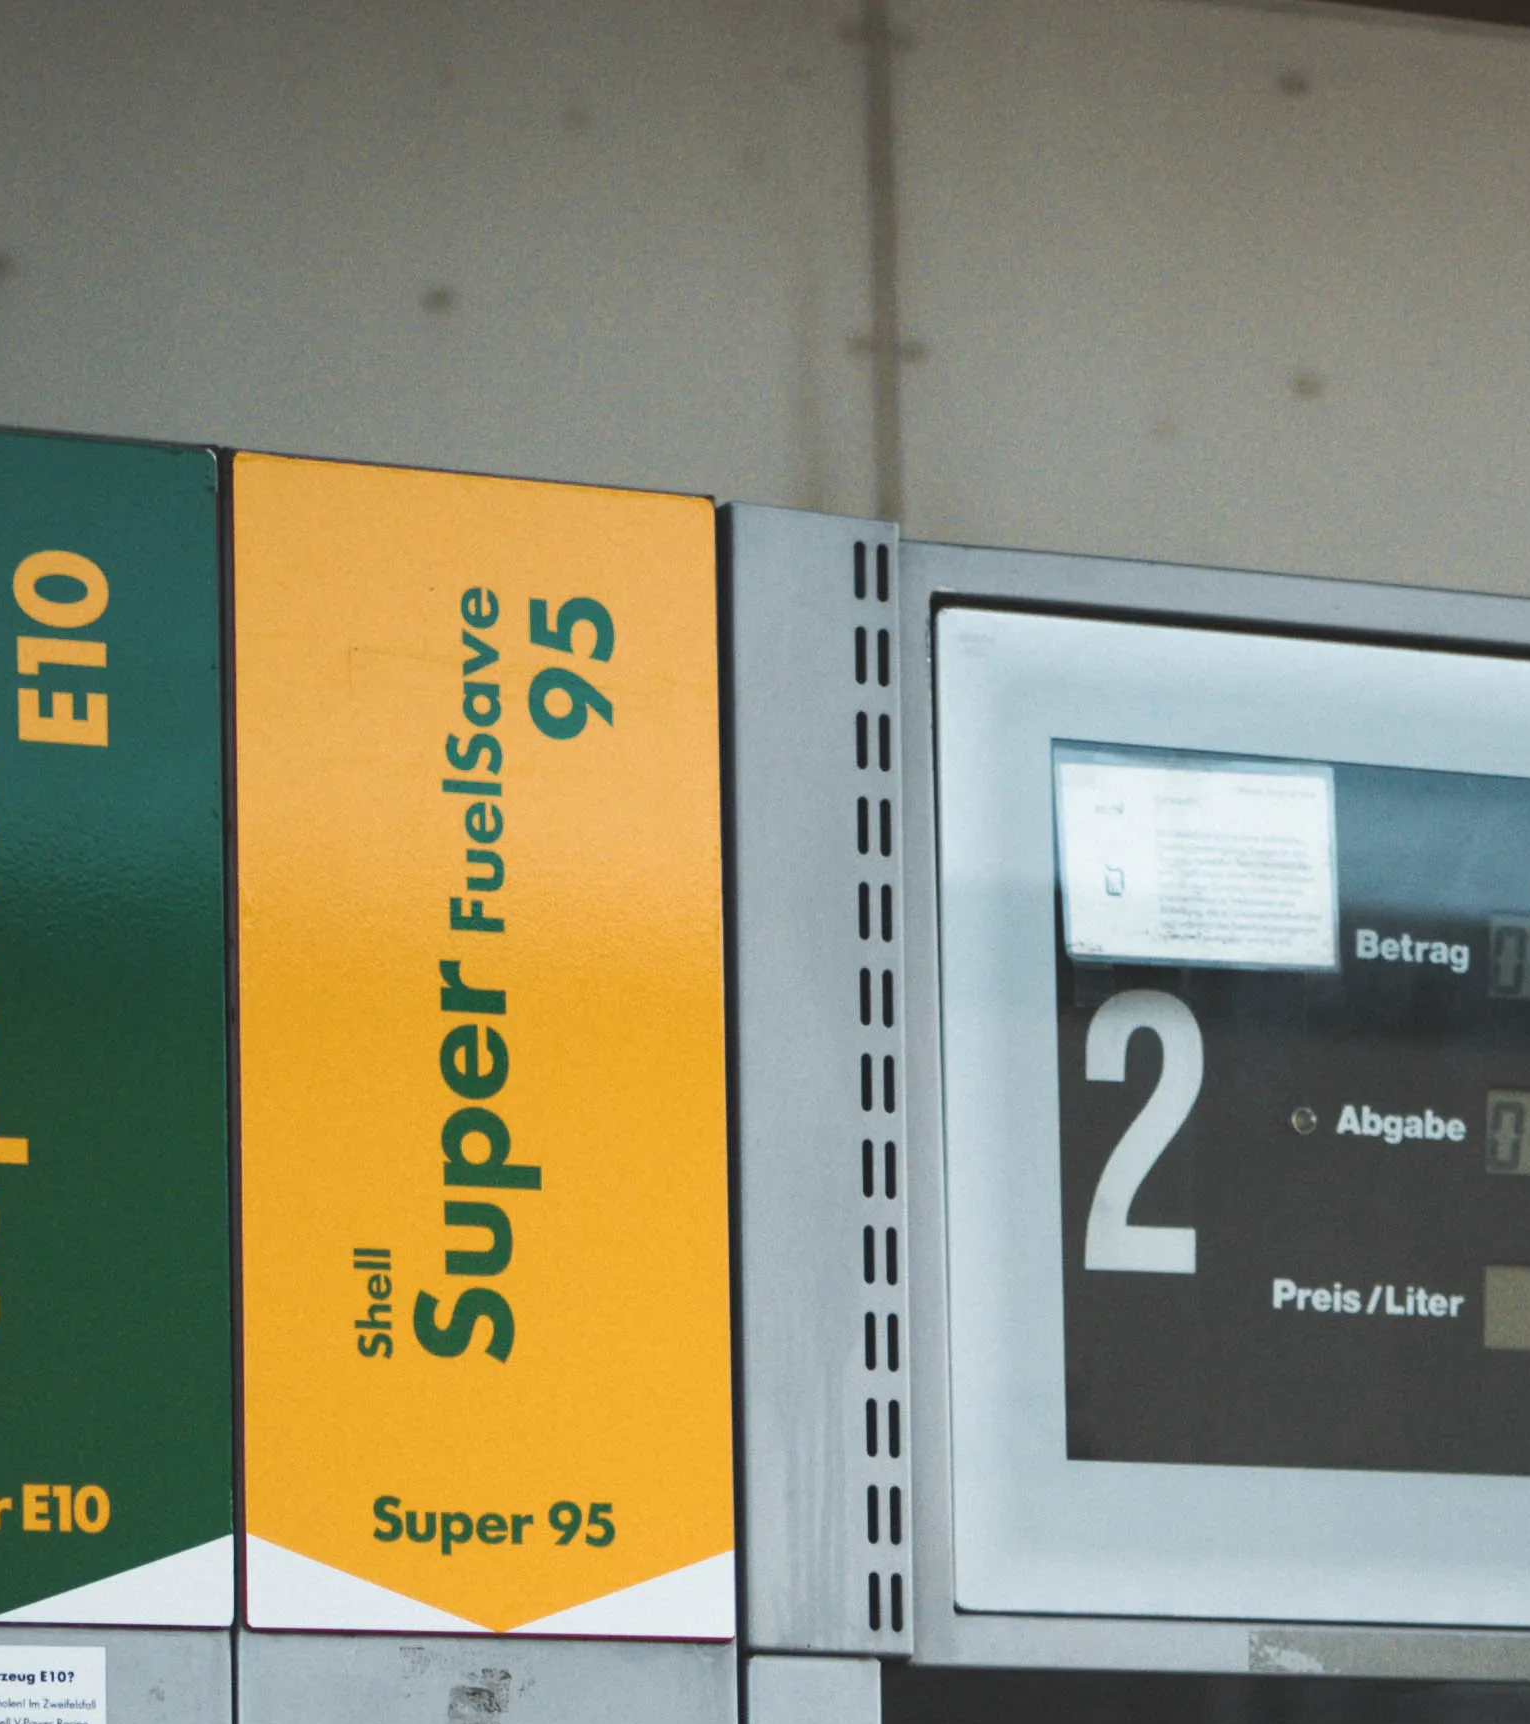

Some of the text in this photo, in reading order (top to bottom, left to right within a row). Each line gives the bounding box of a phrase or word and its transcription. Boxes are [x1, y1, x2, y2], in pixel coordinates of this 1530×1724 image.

[12, 550, 109, 748] E10
[413, 586, 615, 1364] Super FuelSave 95
[1356, 929, 1470, 973] Betrag
[1084, 989, 1204, 1274] 2
[1336, 1105, 1467, 1144] Abgabe
[353, 1247, 392, 1360] Shell
[22, 1483, 110, 1533] E10
[373, 1496, 616, 1555] Super 95
[41, 1671, 75, 1683] E10?
